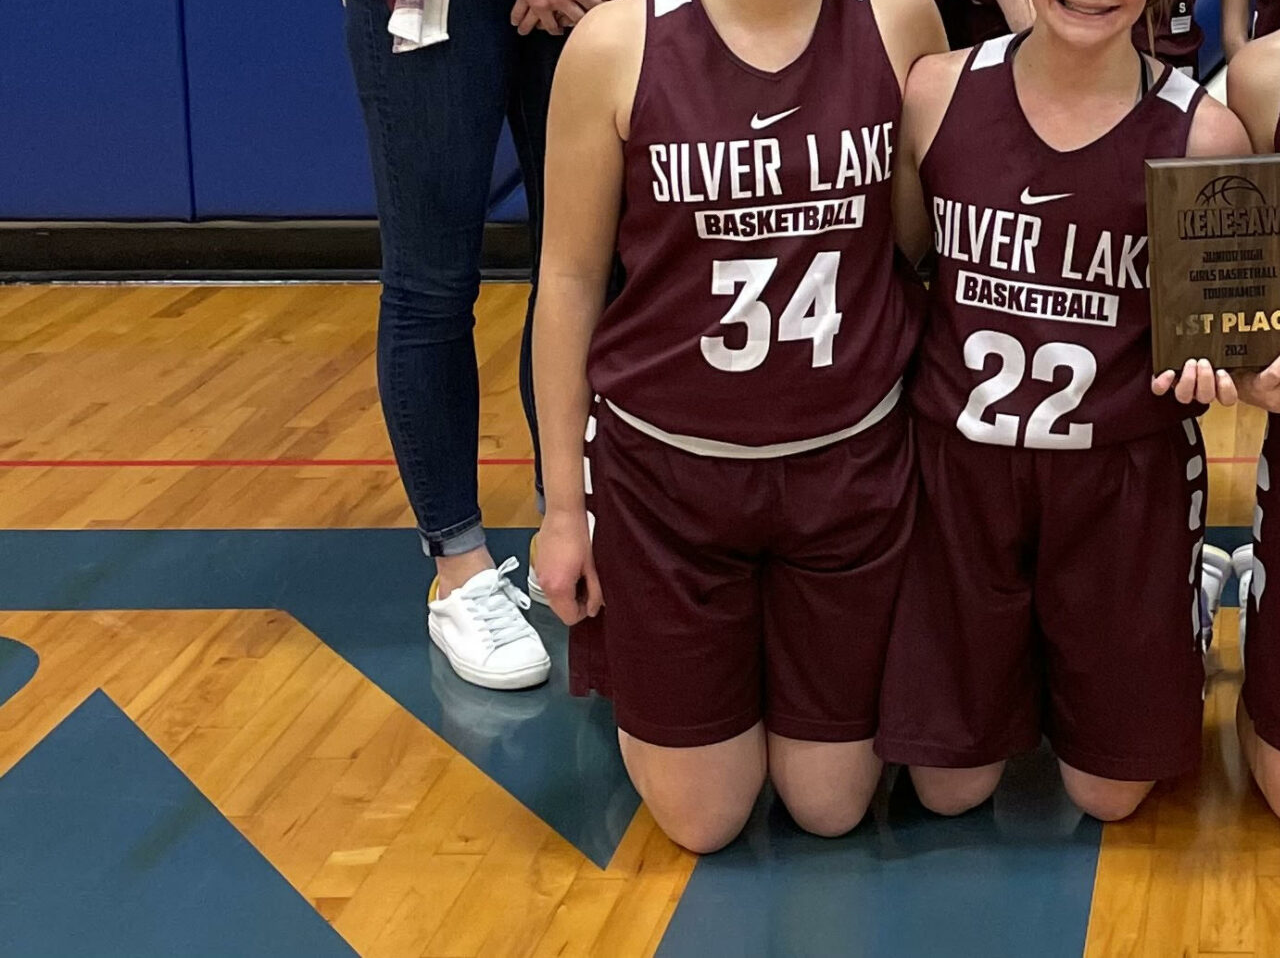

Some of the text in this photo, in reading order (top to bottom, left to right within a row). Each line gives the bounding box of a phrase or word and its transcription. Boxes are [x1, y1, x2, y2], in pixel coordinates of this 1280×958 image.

[1178, 1, 1187, 14] S
[649, 121, 893, 202] SILVER LAKE
[703, 201, 857, 237] BASKETBALL
[933, 196, 1150, 290] SILVER LAK
[1189, 266, 1277, 282] GIRLS BASKETBALL
[963, 276, 1108, 322] BASKETBALL
[1203, 285, 1266, 300] TOURNAMENT
[700, 251, 842, 372] 34
[1175, 313, 1214, 335] 1ST
[1225, 344, 1247, 356] 2021
[956, 330, 1097, 450] 22
